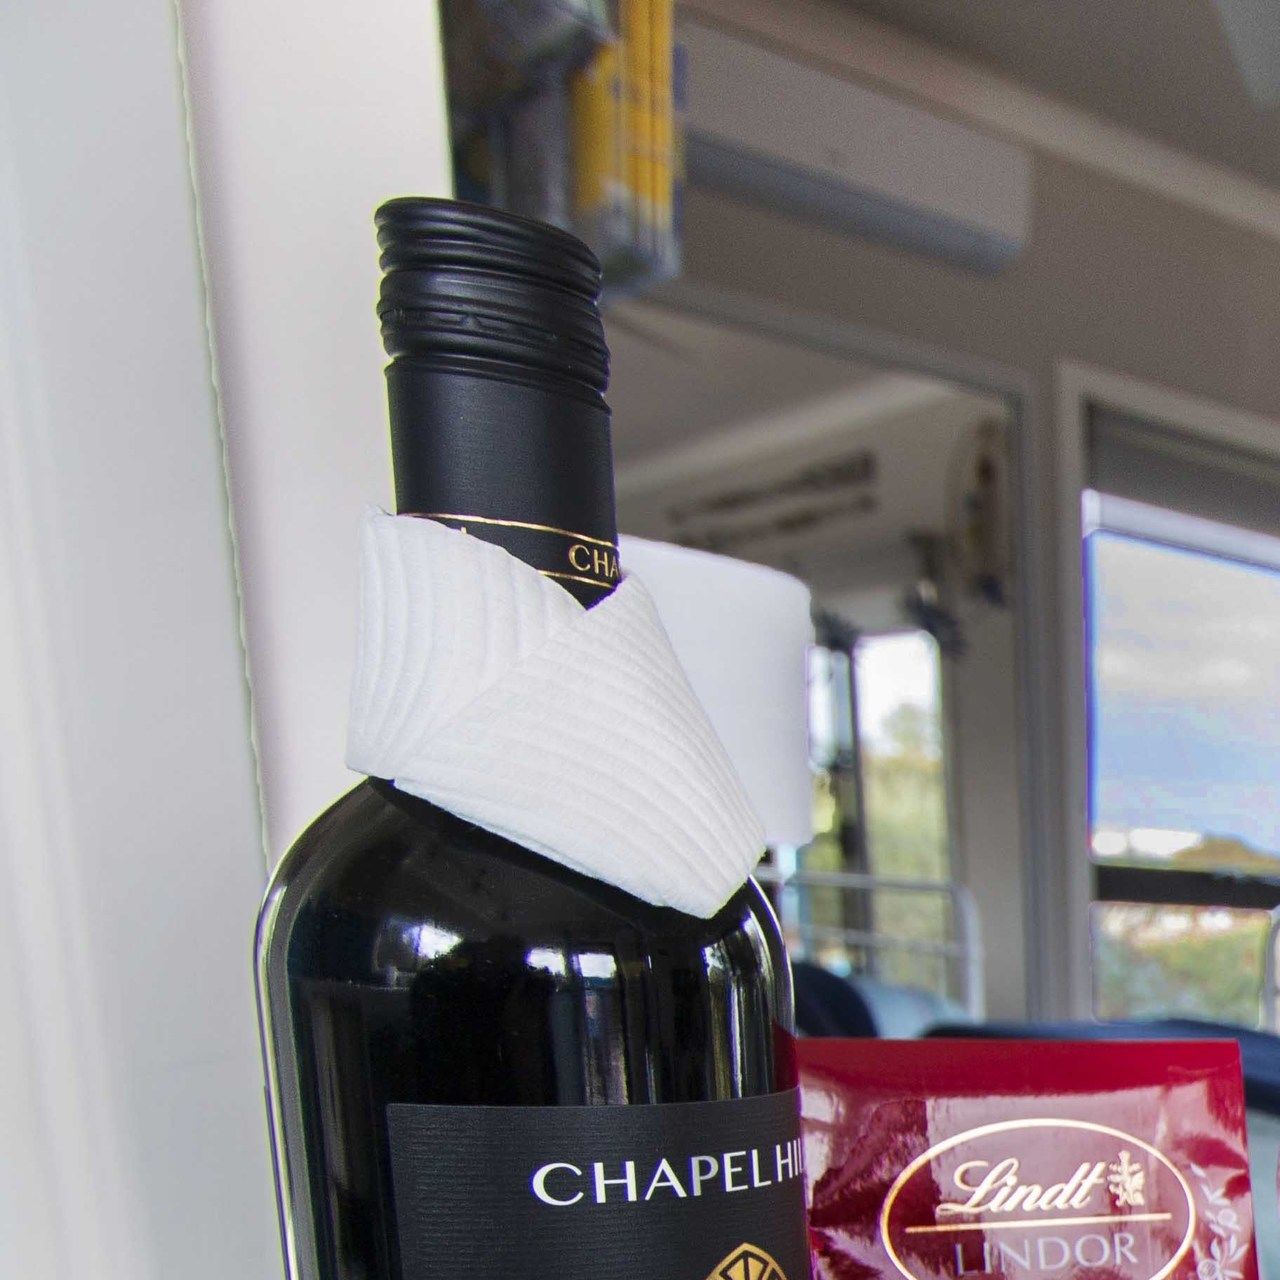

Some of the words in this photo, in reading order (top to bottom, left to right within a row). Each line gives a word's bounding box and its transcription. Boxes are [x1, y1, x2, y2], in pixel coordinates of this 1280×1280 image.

[532, 1148, 772, 1206] CHAPEL
[775, 1138, 804, 1182] HIL
[935, 1157, 1107, 1214] Lindt
[954, 1232, 1138, 1277] LINDOR
